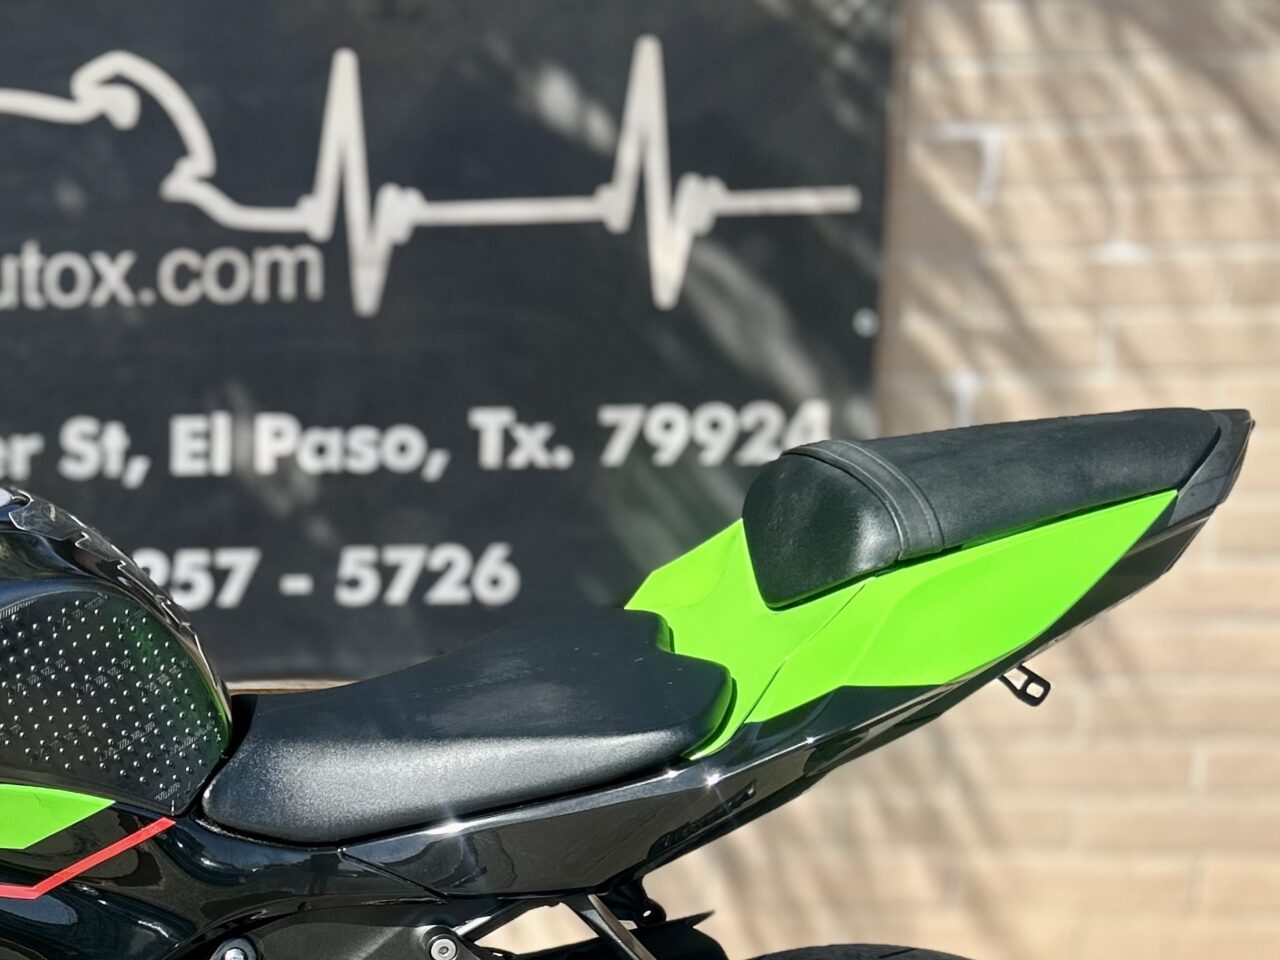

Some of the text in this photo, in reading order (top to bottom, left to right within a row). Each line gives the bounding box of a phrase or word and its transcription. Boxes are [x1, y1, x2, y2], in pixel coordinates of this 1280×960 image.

[58, 414, 152, 489] St,
[168, 410, 233, 477] El
[252, 412, 451, 483] Paso,
[468, 405, 574, 470] Tx.
[597, 399, 832, 467] 79924
[333, 542, 520, 607] 5726
